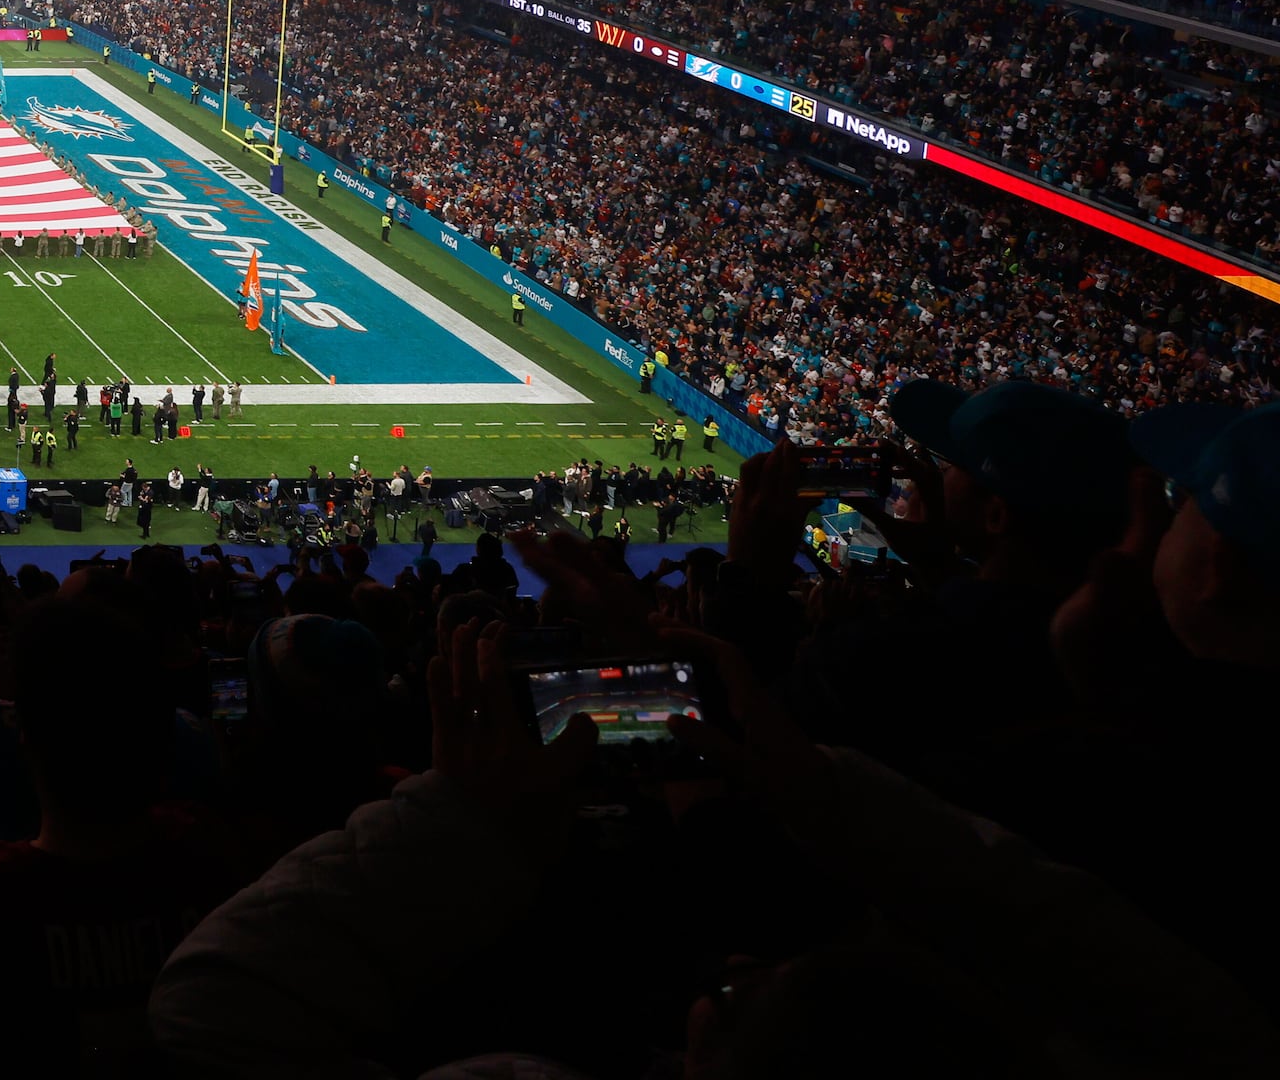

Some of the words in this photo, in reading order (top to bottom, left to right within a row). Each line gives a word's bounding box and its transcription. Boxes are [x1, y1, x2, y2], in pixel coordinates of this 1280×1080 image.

[531, 2, 544, 17] 10
[547, 10, 564, 23] BALL
[565, 15, 575, 26] ON
[576, 18, 591, 34] 35
[633, 36, 643, 52] 0
[730, 72, 741, 89] 0
[792, 95, 814, 118] 25
[845, 114, 911, 156] NetApp
[156, 157, 273, 225] MIAMI
[202, 158, 239, 179] END
[241, 182, 324, 231] RACISM
[333, 168, 376, 200] Dolphins
[440, 231, 459, 251] VISA
[3, 271, 63, 288] 10
[512, 277, 554, 313] Santander
[604, 338, 634, 369] FedEx
